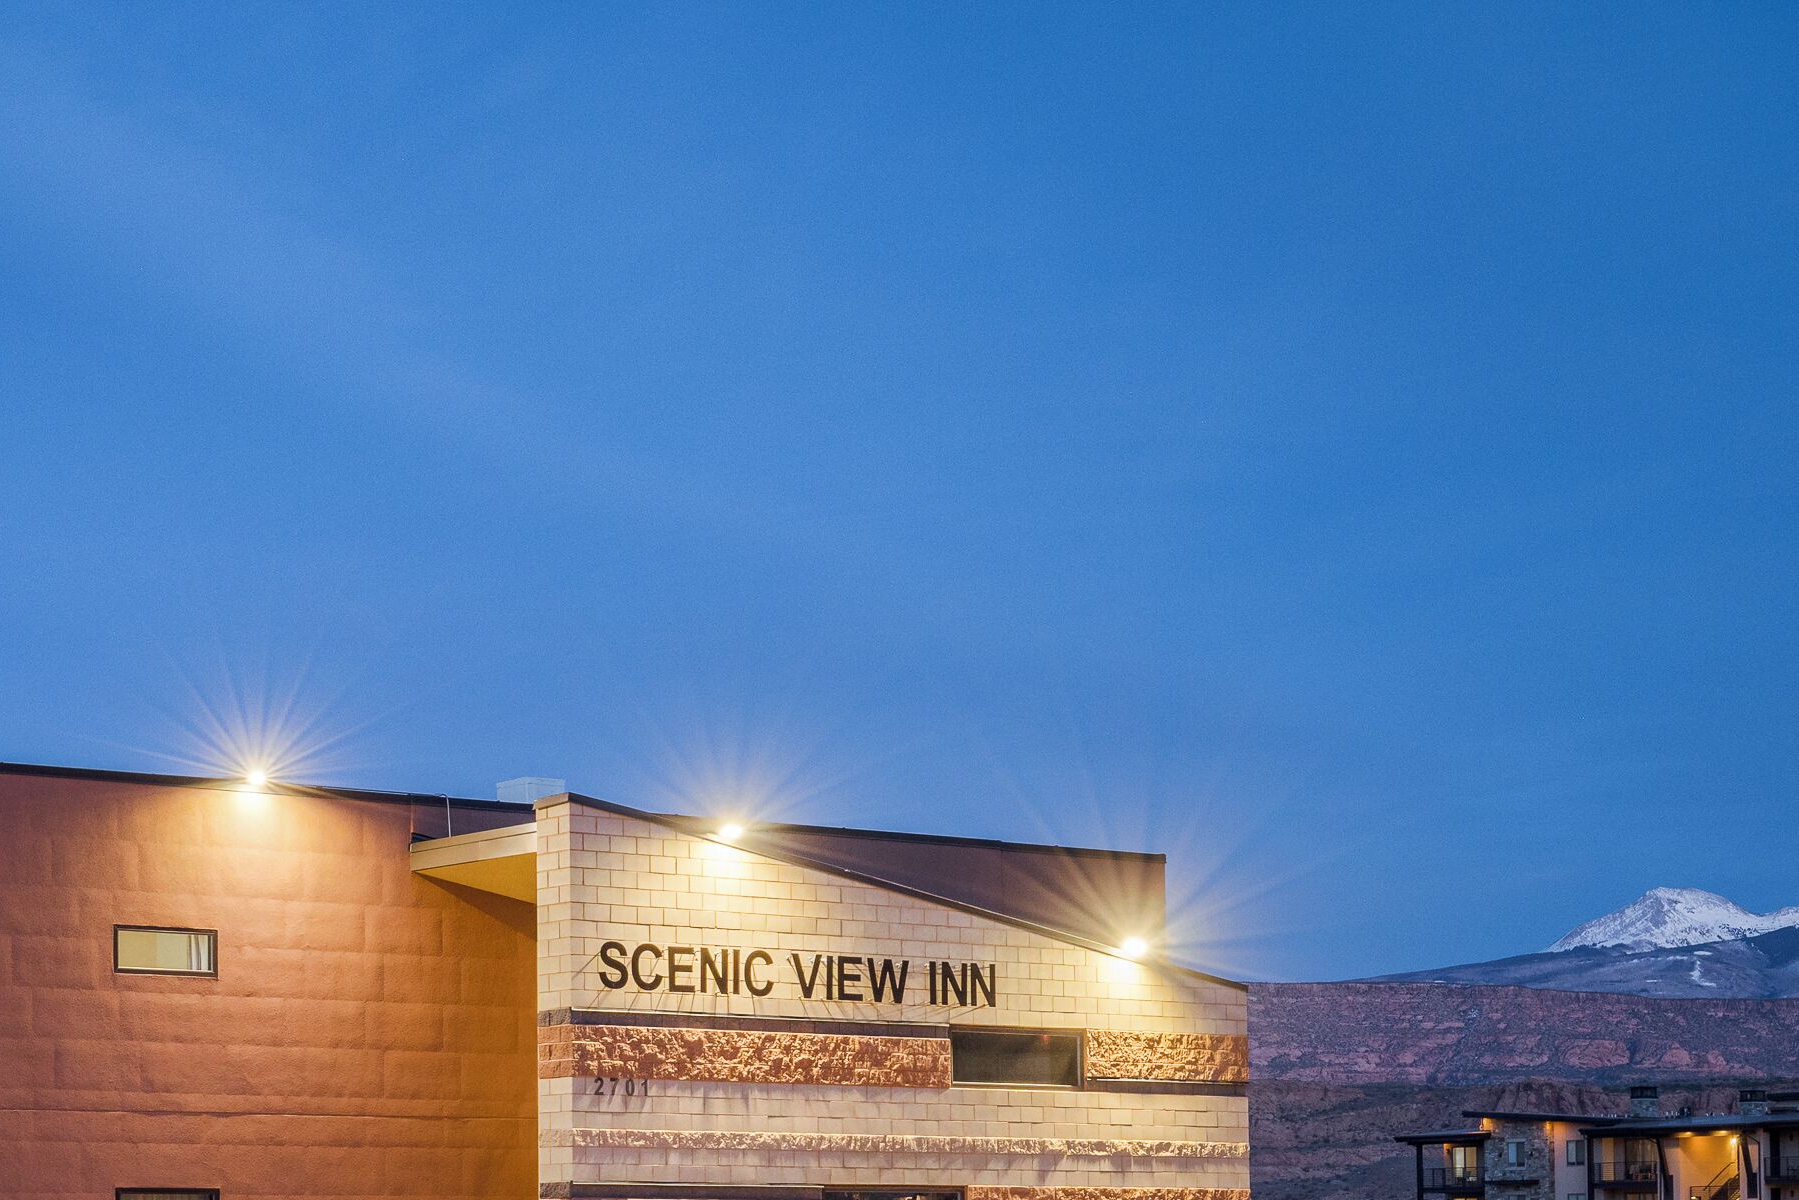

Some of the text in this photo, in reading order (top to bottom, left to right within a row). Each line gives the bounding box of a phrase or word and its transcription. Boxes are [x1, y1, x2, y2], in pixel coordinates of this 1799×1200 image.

[598, 941, 996, 1008] SCENIC VIEW INN
[594, 1076, 649, 1097] 2701
